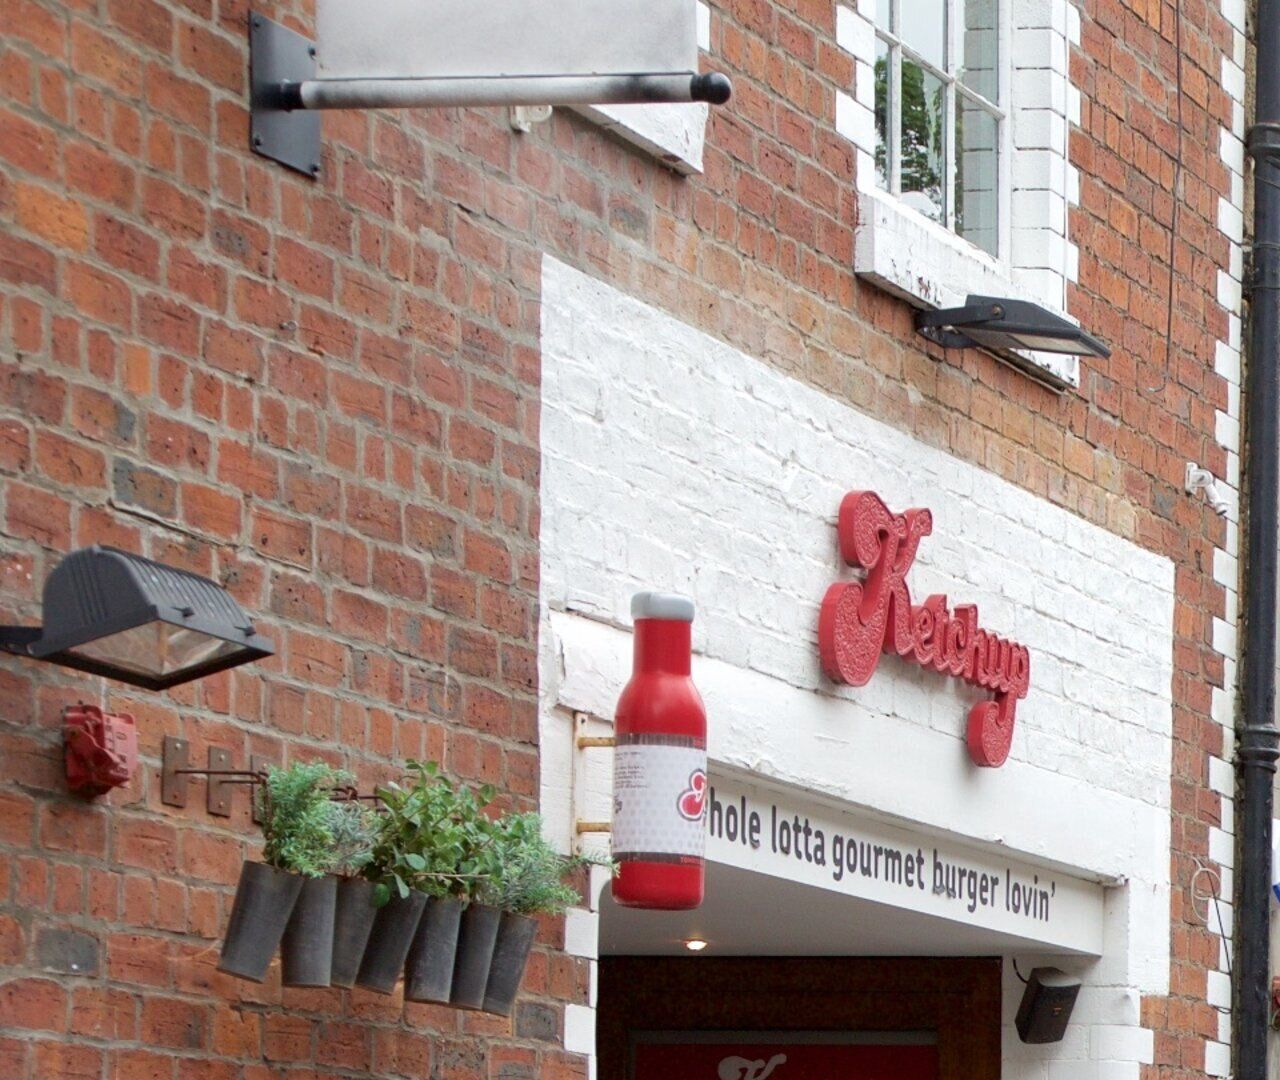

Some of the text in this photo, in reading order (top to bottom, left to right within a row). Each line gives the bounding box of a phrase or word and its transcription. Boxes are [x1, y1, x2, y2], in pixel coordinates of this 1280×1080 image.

[818, 489, 1029, 769] Ketchup
[709, 786, 761, 850] hole
[770, 805, 826, 867] lotta
[832, 833, 925, 891] gourmet
[932, 848, 999, 914] burger
[1005, 868, 1056, 922] lovin'
